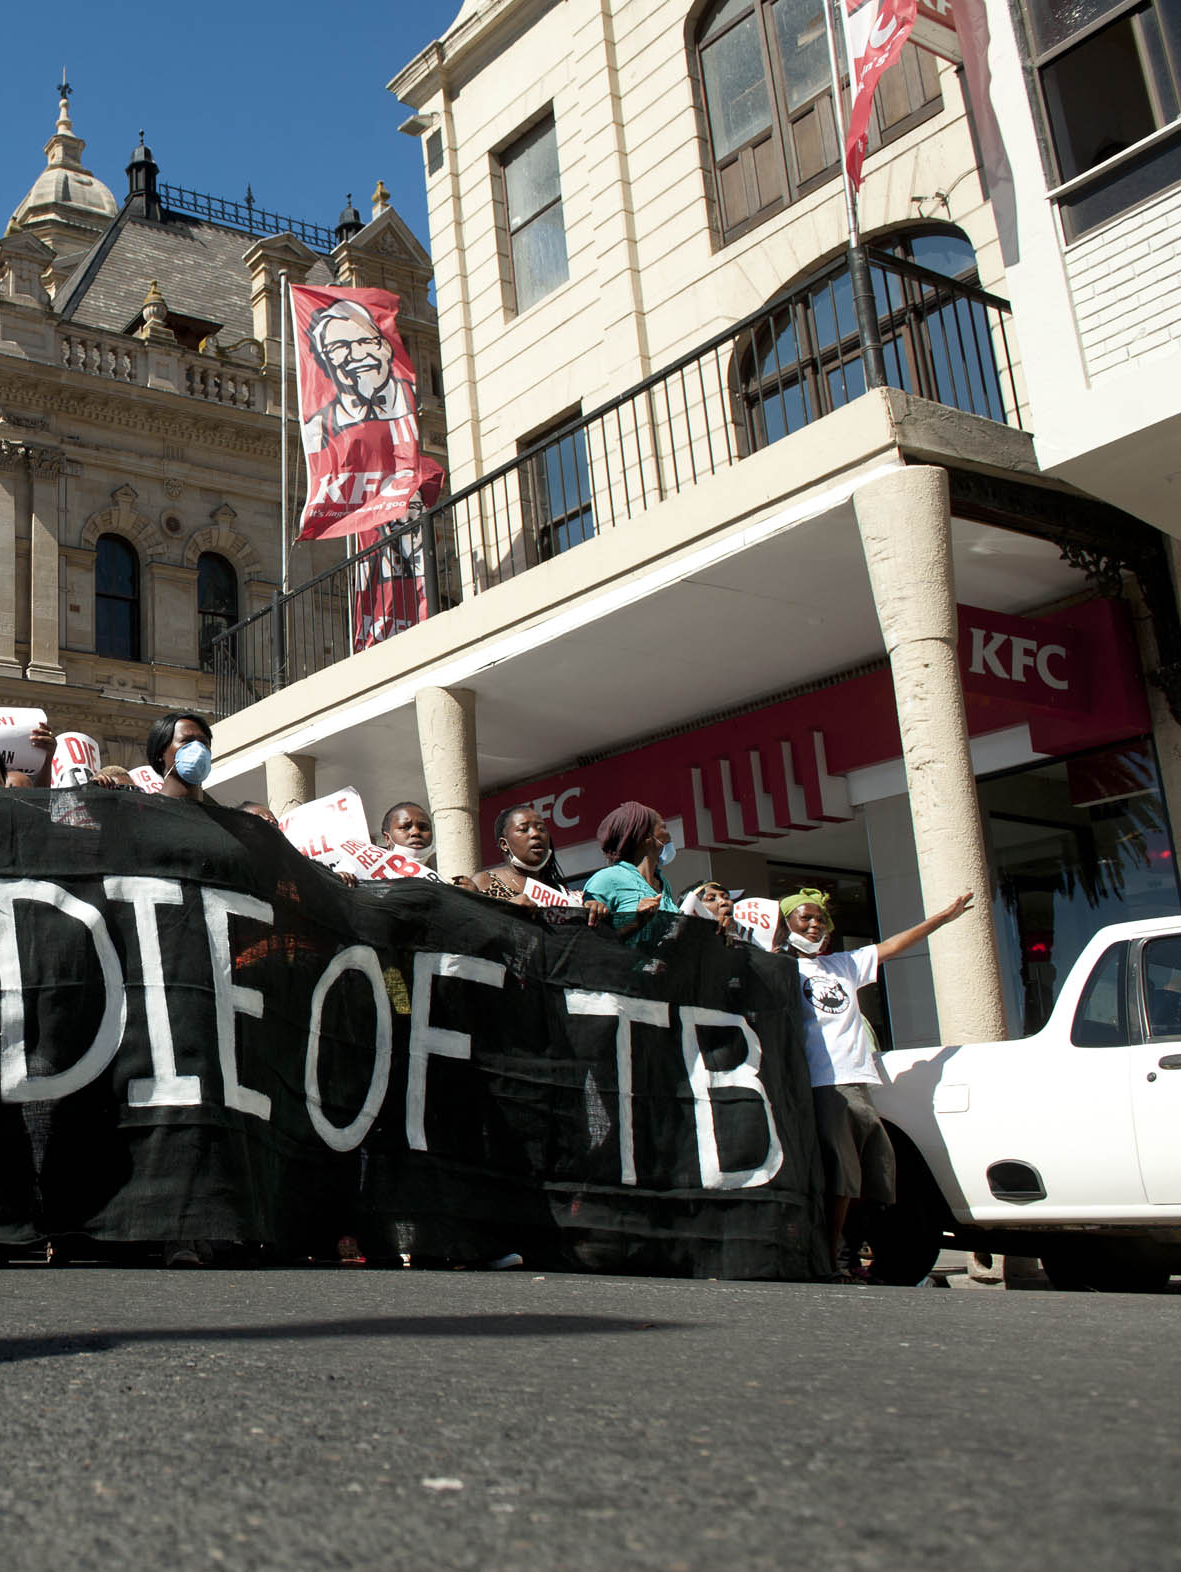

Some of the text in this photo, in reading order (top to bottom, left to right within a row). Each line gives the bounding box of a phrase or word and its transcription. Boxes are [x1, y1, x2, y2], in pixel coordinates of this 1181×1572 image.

[308, 469, 415, 505] KFC
[969, 627, 1069, 690] KFC
[520, 786, 581, 828] FC
